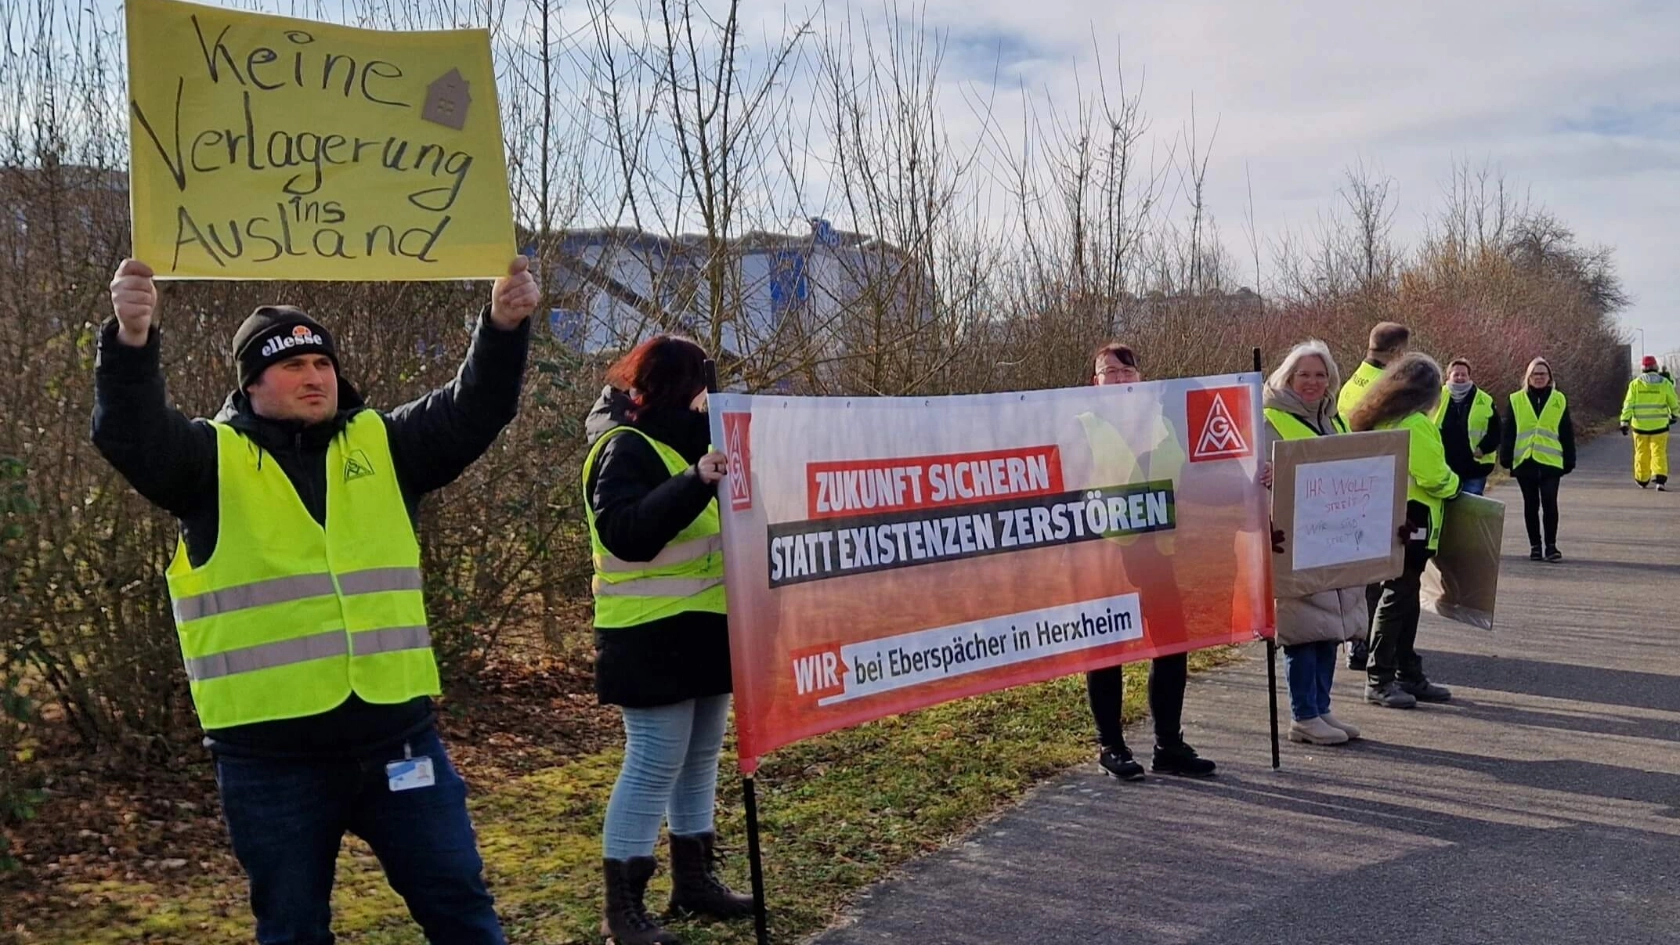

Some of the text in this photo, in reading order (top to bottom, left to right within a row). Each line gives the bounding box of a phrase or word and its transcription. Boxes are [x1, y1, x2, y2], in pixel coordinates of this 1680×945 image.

[191, 13, 411, 108] Keine
[131, 76, 474, 211] Verlagerung
[172, 203, 451, 272] Ausland
[292, 196, 345, 224] ins
[261, 332, 323, 357] ellesse
[815, 454, 1050, 512] ZUKUNFT SICHERN
[1305, 477, 1326, 499] IHR
[771, 490, 1168, 581] STATT EXISTENZEN ZERSTÖREN
[793, 607, 1132, 695] WIR bei Eberspächer in Herxheim
